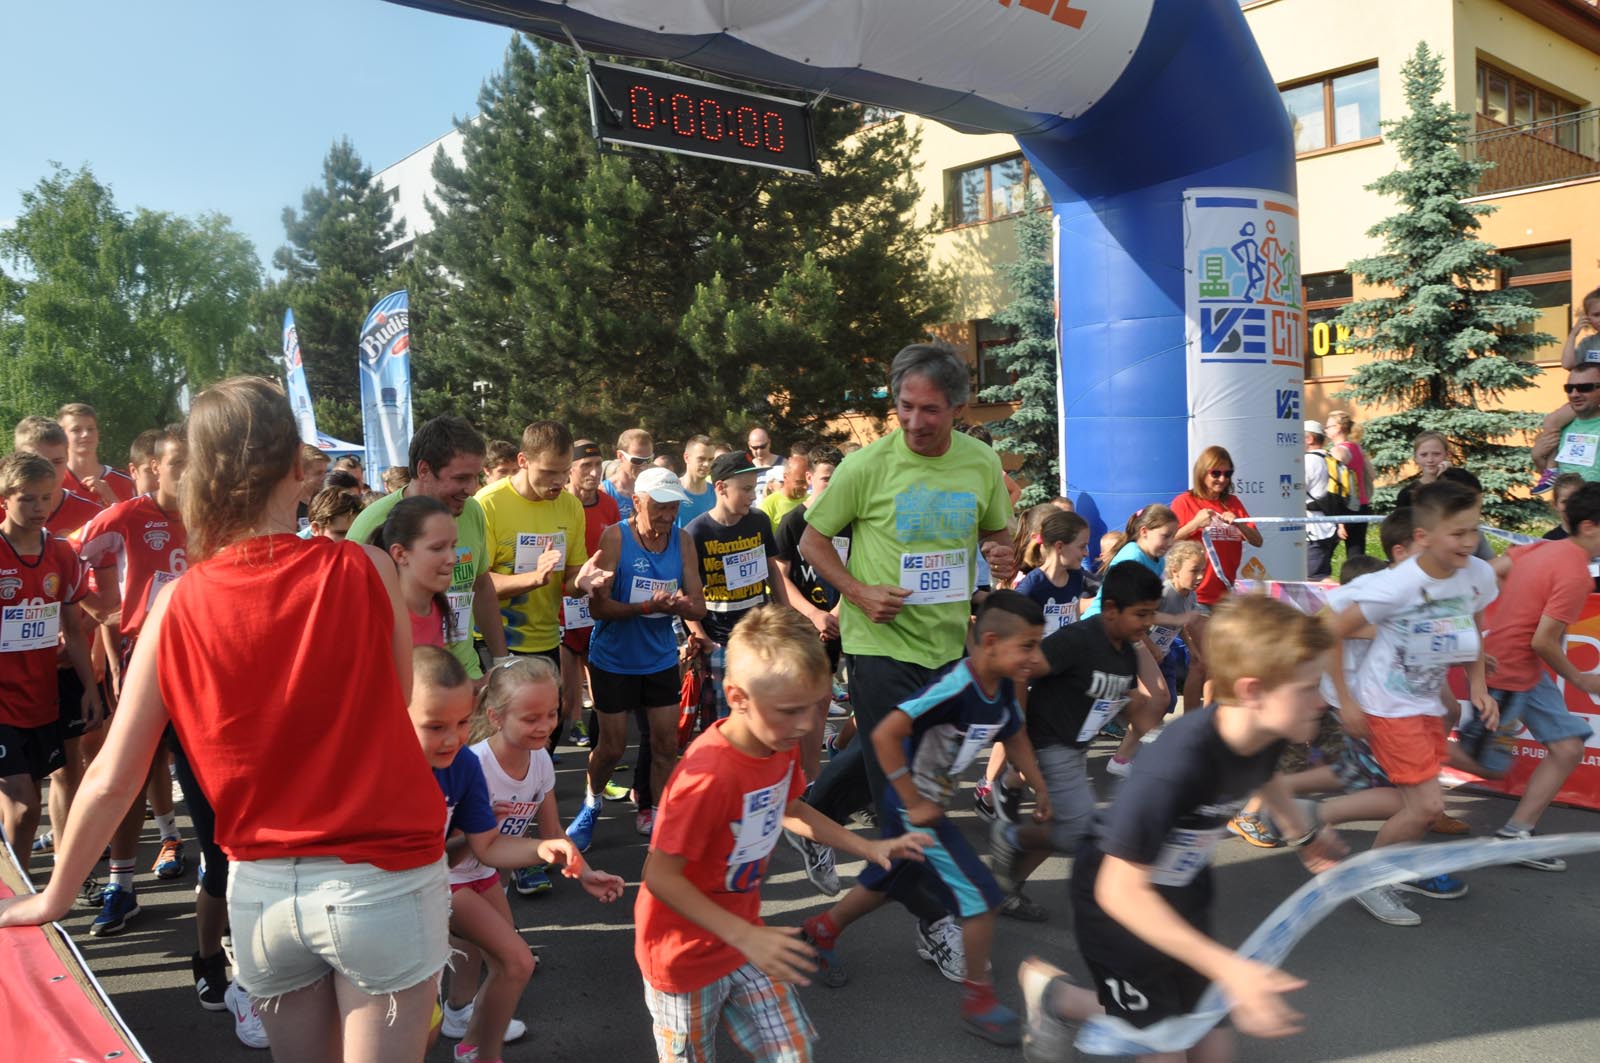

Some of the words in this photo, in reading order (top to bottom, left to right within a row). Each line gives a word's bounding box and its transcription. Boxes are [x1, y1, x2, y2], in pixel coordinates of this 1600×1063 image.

[631, 86, 785, 152] 0:00:00
[1277, 432, 1298, 443] RWE
[704, 532, 762, 555] Warning!
[739, 560, 759, 578] 677
[920, 570, 951, 591] 666
[21, 621, 46, 639] 610
[1105, 977, 1150, 1012] 15
